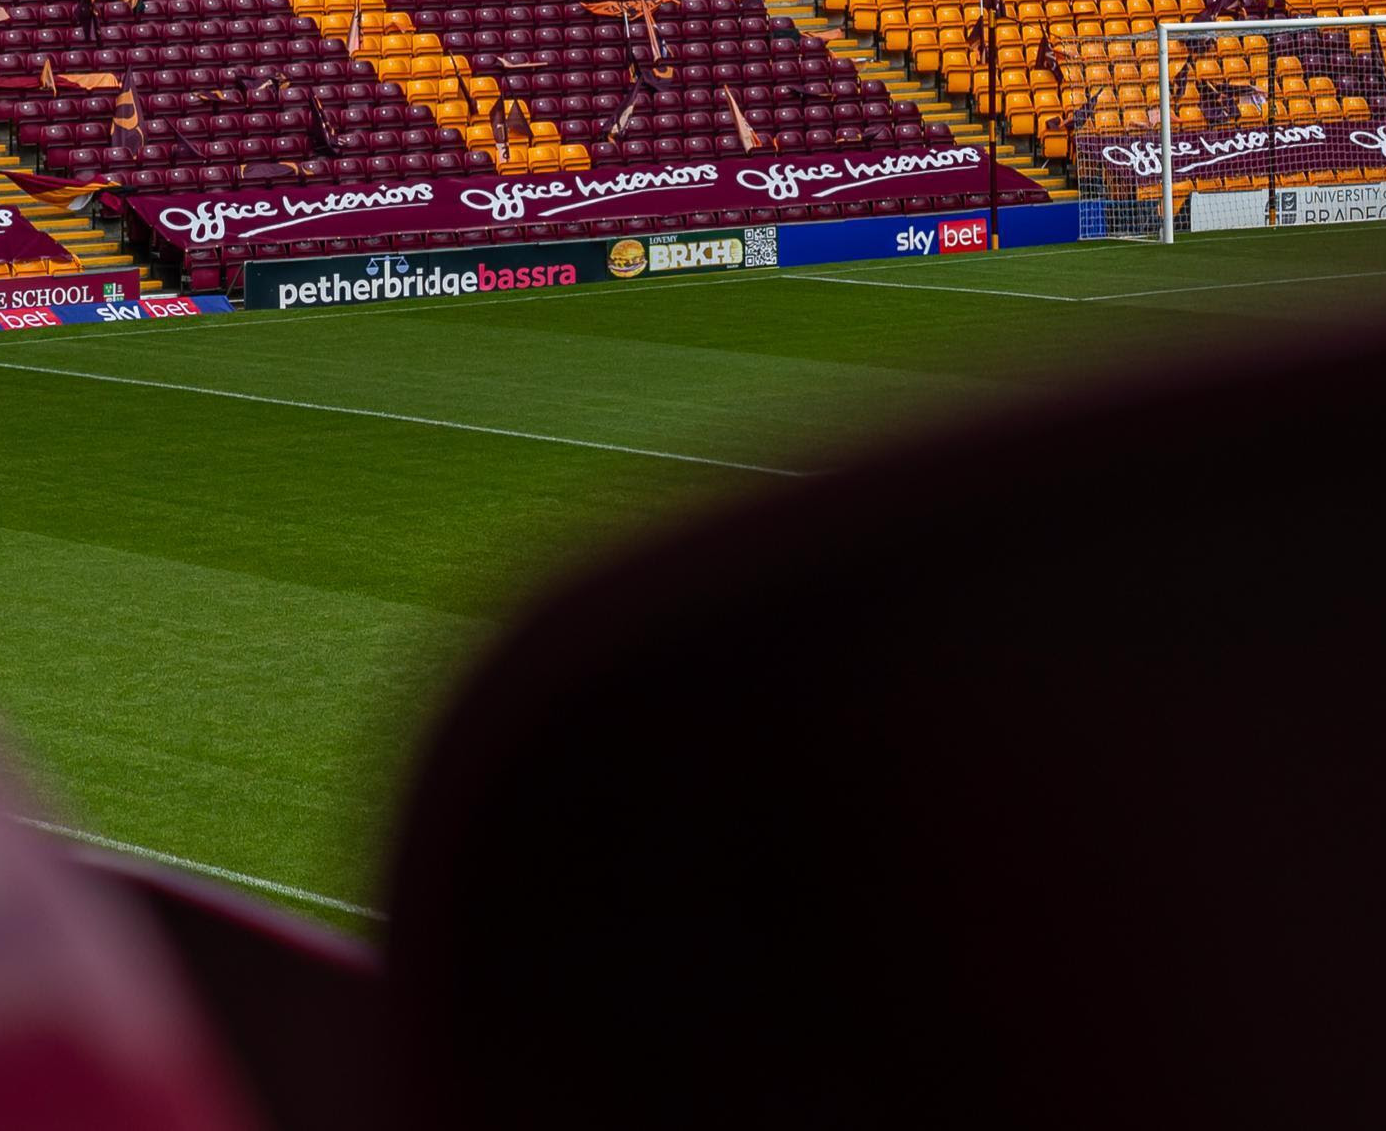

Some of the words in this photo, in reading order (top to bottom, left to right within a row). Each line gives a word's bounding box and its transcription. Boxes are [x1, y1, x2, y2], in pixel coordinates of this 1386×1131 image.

[737, 161, 843, 199] Office
[845, 147, 981, 179] Interiors
[1103, 140, 1200, 176] Offce
[460, 181, 572, 221] Office
[575, 164, 719, 197] Interiors
[1305, 187, 1380, 205] UNIVERSITY
[160, 201, 277, 243] Office
[283, 183, 433, 217] Interiors
[896, 225, 935, 255] sky
[943, 224, 983, 248] bet
[12, 285, 94, 309] SCHOOL
[97, 302, 142, 322] sky
[146, 300, 197, 318] bet
